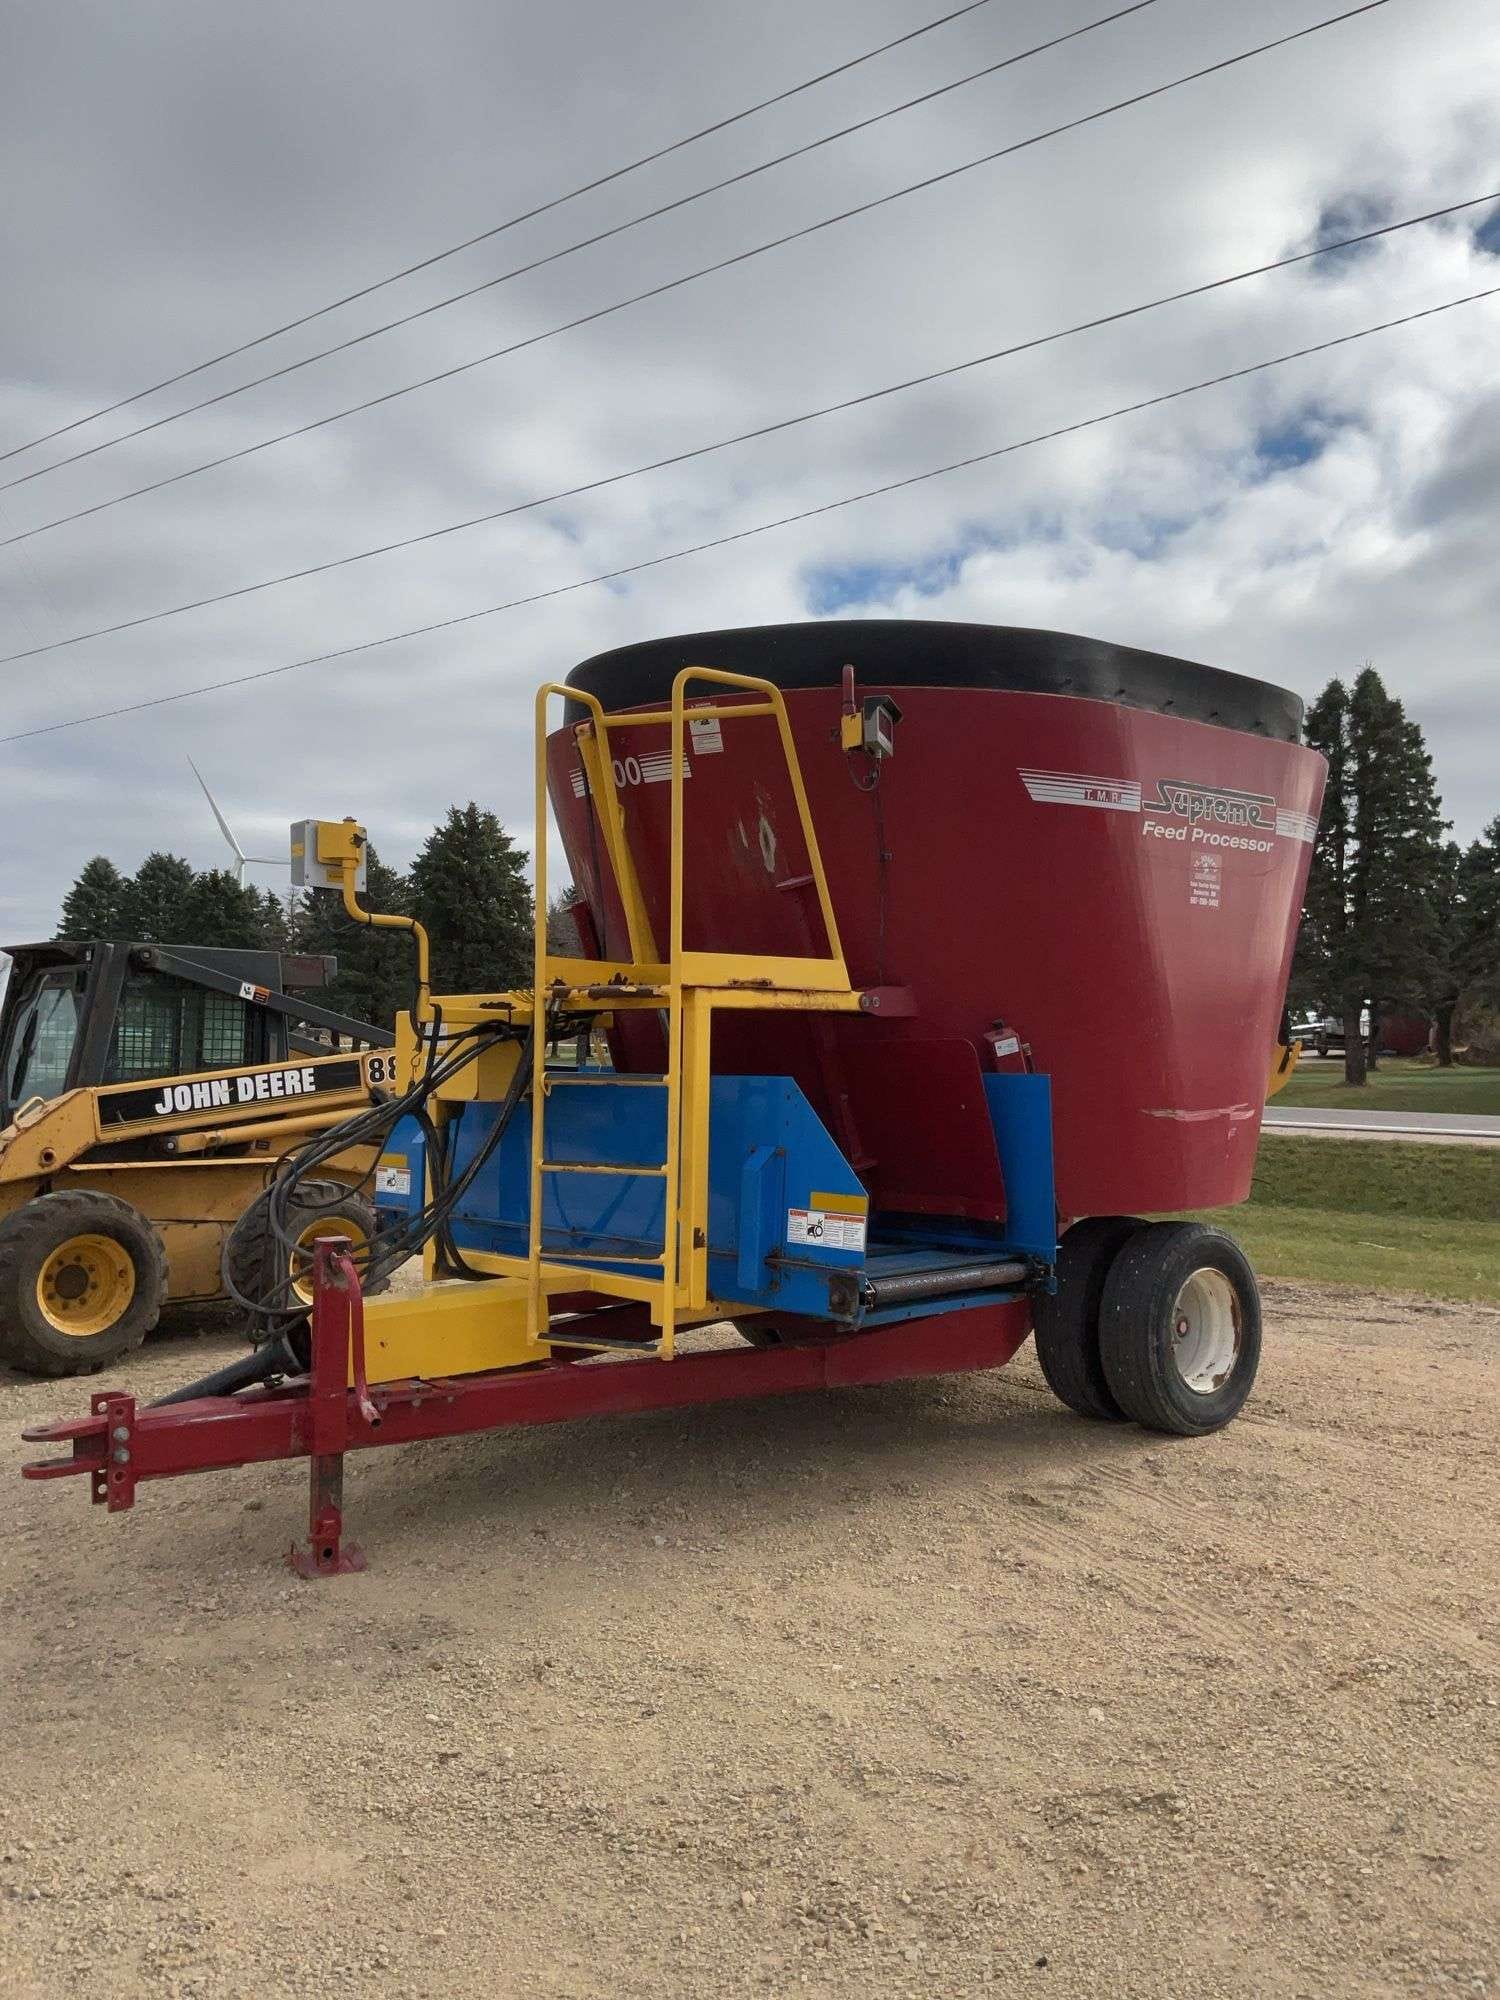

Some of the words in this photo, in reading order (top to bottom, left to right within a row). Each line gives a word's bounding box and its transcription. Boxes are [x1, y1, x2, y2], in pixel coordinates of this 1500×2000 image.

[1142, 777, 1276, 831] Supreme
[1142, 820, 1188, 841] Feed
[1191, 828, 1274, 853] Processor
[155, 1080, 230, 1115] JOHN
[237, 1067, 316, 1102] DEERE
